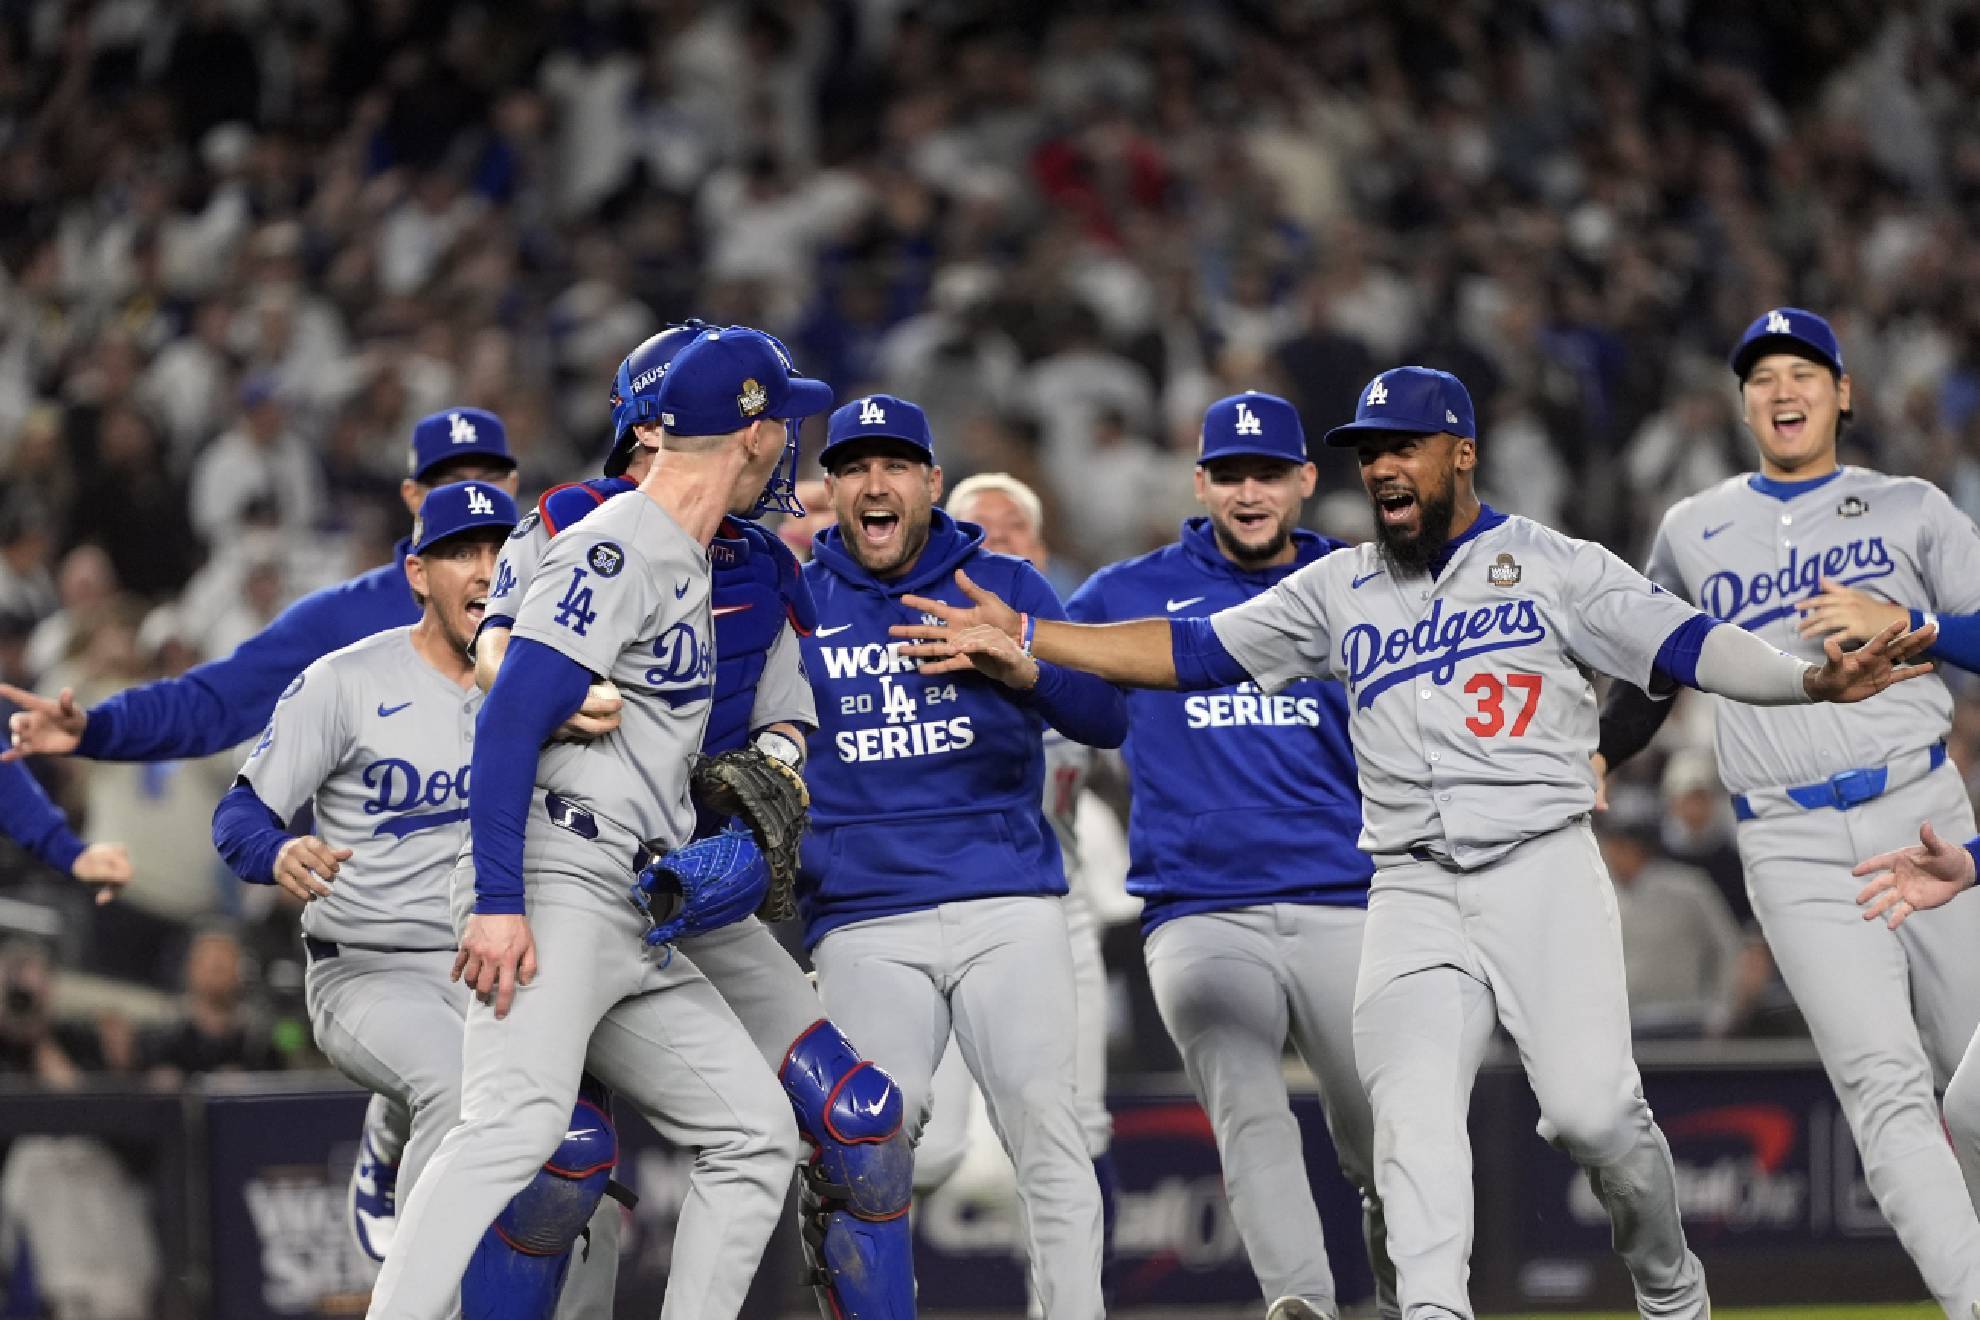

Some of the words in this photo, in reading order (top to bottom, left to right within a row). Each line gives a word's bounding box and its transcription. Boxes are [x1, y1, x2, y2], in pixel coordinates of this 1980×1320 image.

[1766, 310, 1792, 334] LA
[448, 413, 478, 444] LA
[858, 397, 886, 425] LA
[1235, 403, 1262, 435] LA
[464, 486, 495, 515] LA
[1700, 536, 1895, 624] Dodgers
[554, 567, 597, 637] LA
[1342, 598, 1546, 692] Dodgers
[840, 694, 873, 714] 20
[879, 675, 917, 723] LA
[923, 683, 958, 705] 24
[1184, 692, 1320, 729] SERIES
[1463, 673, 1543, 737] 37
[835, 716, 975, 763] SERIES
